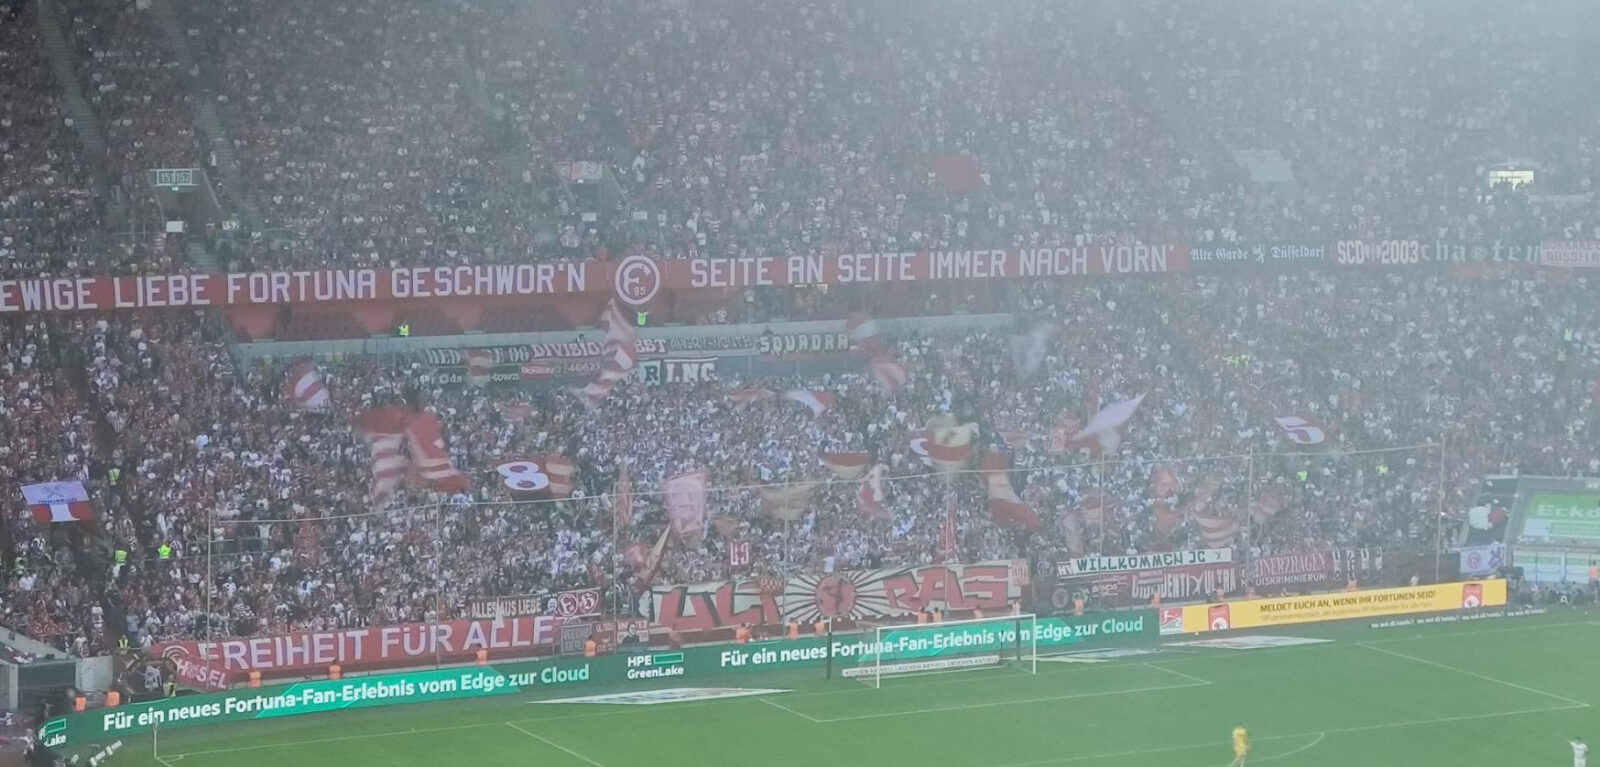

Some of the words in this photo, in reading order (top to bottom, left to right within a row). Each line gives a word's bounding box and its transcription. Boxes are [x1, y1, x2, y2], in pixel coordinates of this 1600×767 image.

[1215, 248, 1248, 262] Garde
[1336, 240, 1365, 265] SCD
[1381, 239, 1418, 265] 2003
[690, 257, 773, 288] SEITE
[786, 255, 824, 285] AN
[836, 253, 916, 283] SEITE
[929, 250, 1006, 280] IMMER
[1018, 247, 1088, 277] NACH
[0, 277, 98, 311] EWIGE
[113, 275, 210, 307] LIEBE
[226, 268, 377, 304] FORTUNA
[390, 262, 585, 298] GESCHWOR'N
[759, 333, 849, 357] SQUADRA
[497, 461, 550, 491] 8
[1076, 555, 1183, 573] WILLKOMMEN
[471, 600, 496, 619] ALLES
[518, 597, 542, 615] LIEBE
[1260, 602, 1293, 613] MELDET
[1294, 601, 1316, 611] EUCH
[1317, 599, 1331, 609] AN,
[1333, 597, 1357, 607] WENN
[1359, 594, 1372, 604] IHR
[1373, 591, 1415, 603] FORTUNEN
[1416, 590, 1436, 600] SEID!
[197, 629, 369, 671] FREIHEIT
[381, 623, 454, 659] FÜR
[463, 616, 555, 653] ALLE
[720, 647, 748, 667] Für
[752, 647, 777, 665] ein
[781, 644, 828, 663] neues
[831, 630, 995, 659] Fortuna-Fan-Erlebnis
[998, 629, 1031, 643] vom
[1034, 623, 1072, 644] Edge
[1074, 622, 1098, 637] zur
[1101, 616, 1144, 635] Cloud
[627, 654, 653, 668] HPE
[627, 664, 685, 680] GreenLake
[103, 711, 133, 731] Für
[137, 706, 165, 727] ein
[168, 699, 221, 722] neues
[224, 680, 415, 716] Fortuna-Fan-Erlebnis
[419, 678, 457, 694] vom
[460, 672, 505, 693] Edge
[509, 670, 538, 687] zur
[540, 664, 590, 684] Cloud
